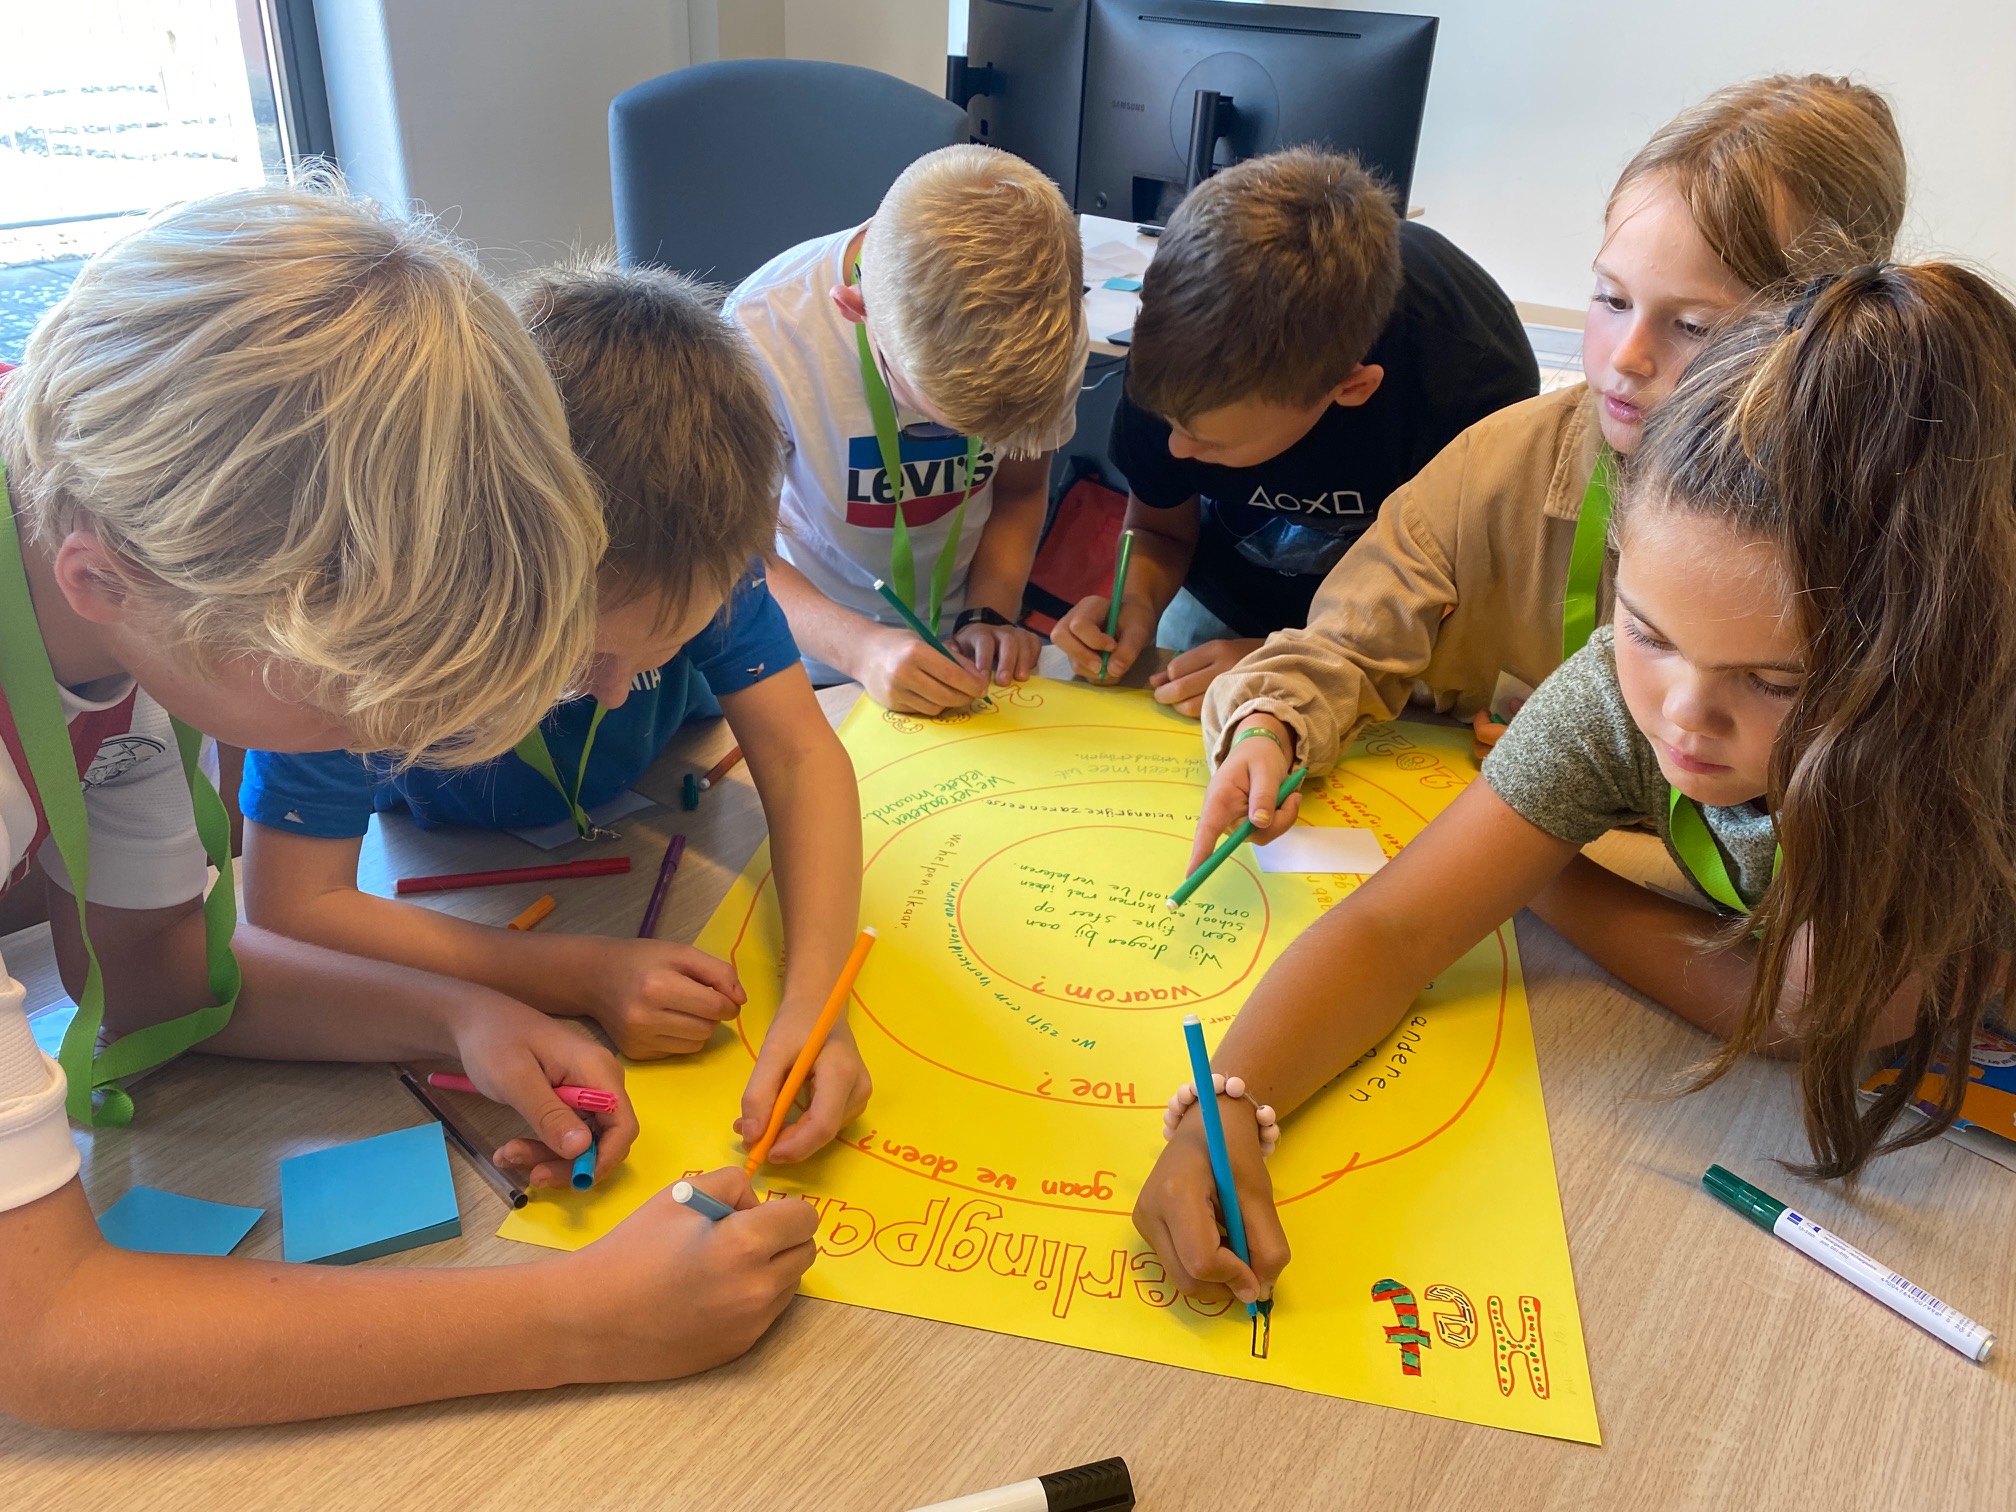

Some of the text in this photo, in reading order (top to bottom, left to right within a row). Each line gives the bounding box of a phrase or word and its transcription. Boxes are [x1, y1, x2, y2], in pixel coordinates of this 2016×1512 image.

[1112, 100, 1145, 112] SAMSUNG
[1088, 765, 1129, 774] mee
[1034, 901, 1055, 914] op
[1224, 908, 1250, 919] om
[1025, 919, 1060, 932] aan
[1041, 1170, 1117, 1202] gaan
[1371, 1278, 1550, 1400] Het
